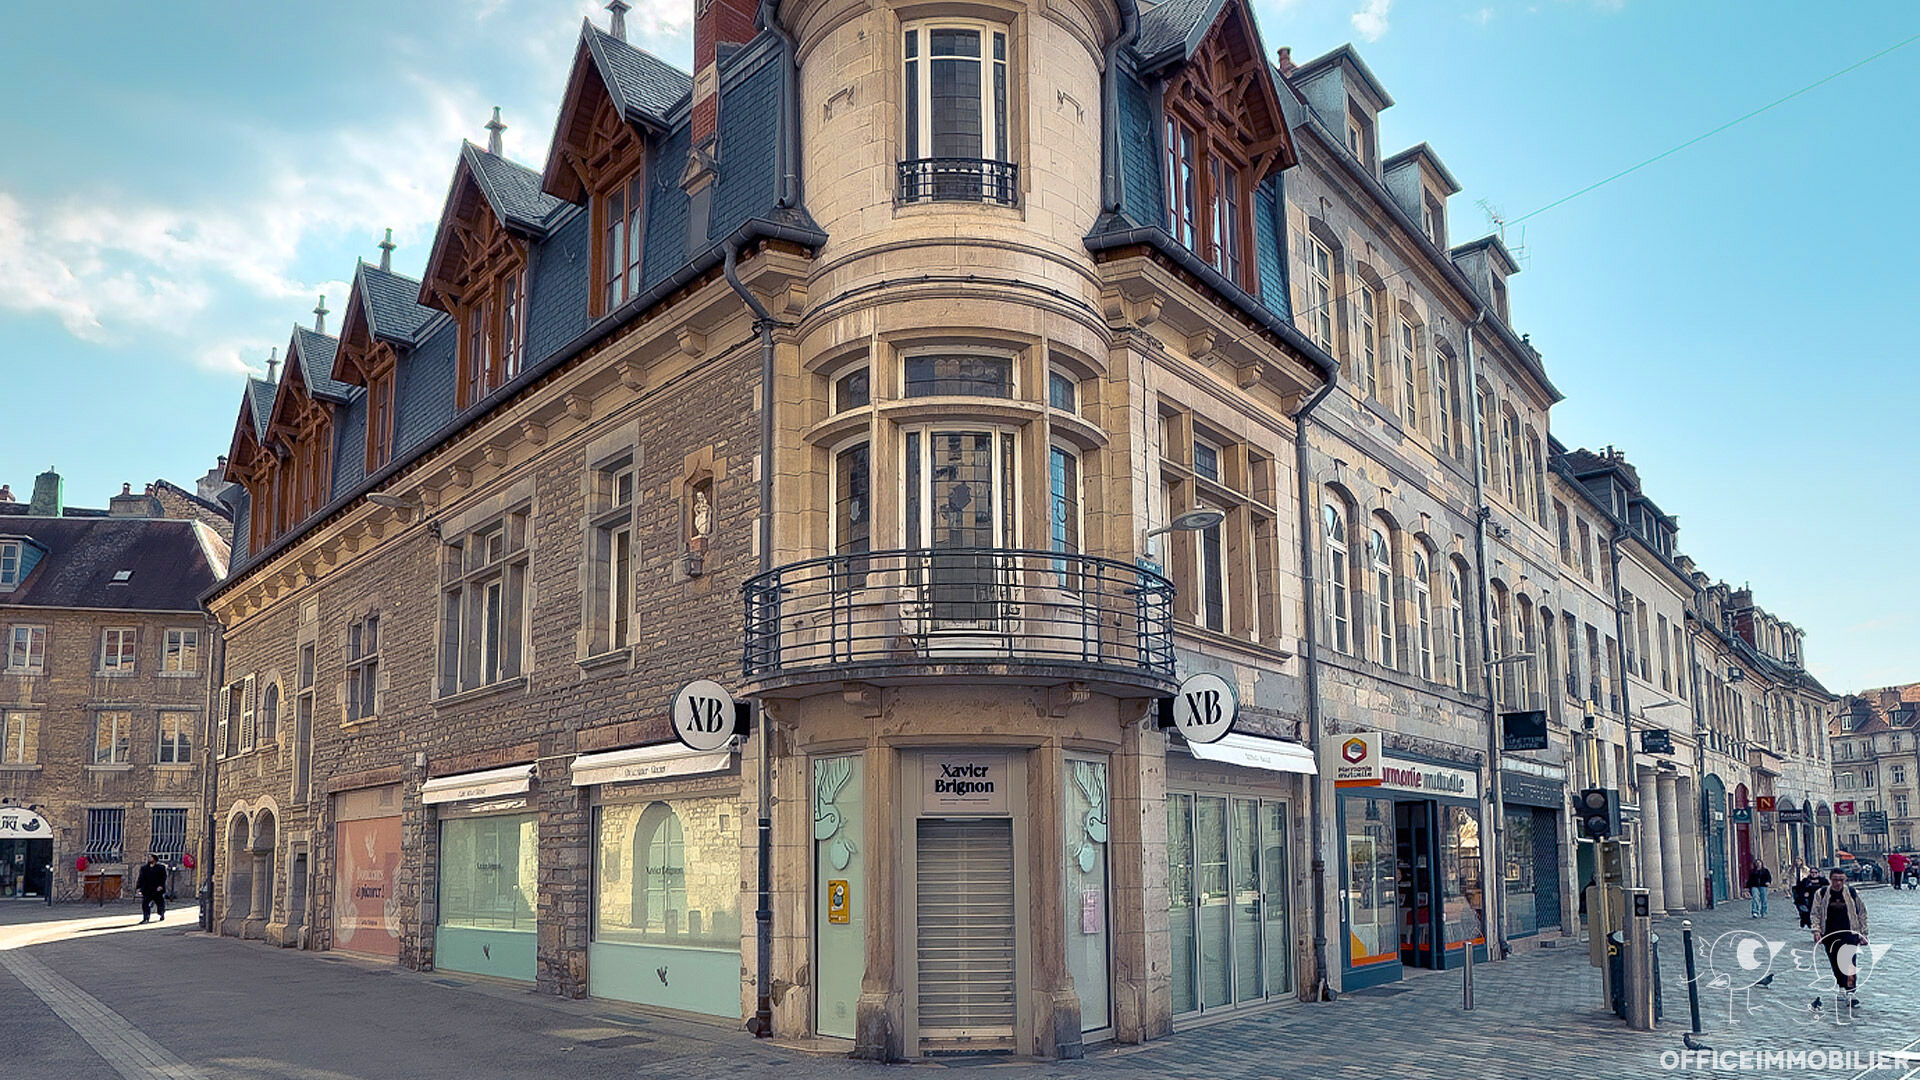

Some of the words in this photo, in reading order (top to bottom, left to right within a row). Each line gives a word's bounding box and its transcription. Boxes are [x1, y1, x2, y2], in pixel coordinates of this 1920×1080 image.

[686, 696, 723, 732] XB
[1185, 690, 1222, 727] XB
[940, 763, 989, 778] Xavier
[1338, 765, 1372, 773] Harmonie
[935, 778, 994, 796] Brignon
[1423, 772, 1464, 793] mutuelle
[1761, 798, 1771, 808] N
